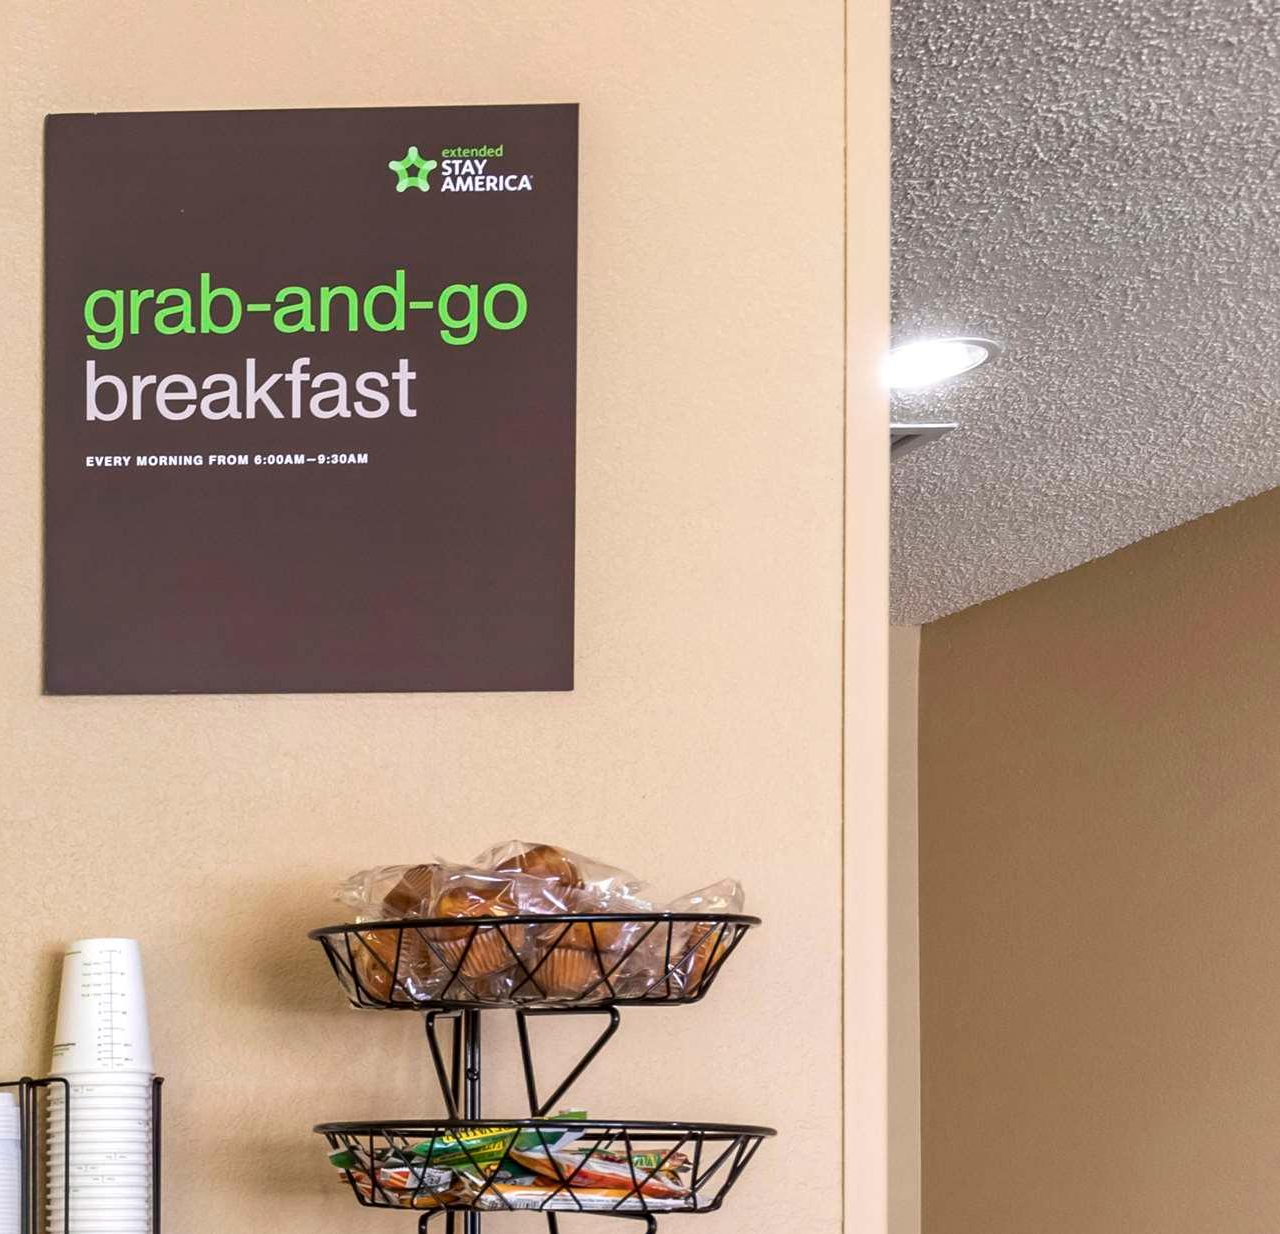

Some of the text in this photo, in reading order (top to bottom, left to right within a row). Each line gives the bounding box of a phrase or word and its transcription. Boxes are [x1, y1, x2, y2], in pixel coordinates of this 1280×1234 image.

[441, 144, 504, 158] extended
[441, 159, 488, 176] STAY
[441, 174, 533, 193] AMERICA
[83, 269, 529, 351] grab-and-go
[85, 356, 418, 422] breakfast
[85, 455, 131, 467] EVERY
[136, 454, 204, 467] MORNING
[208, 454, 249, 466] FROM
